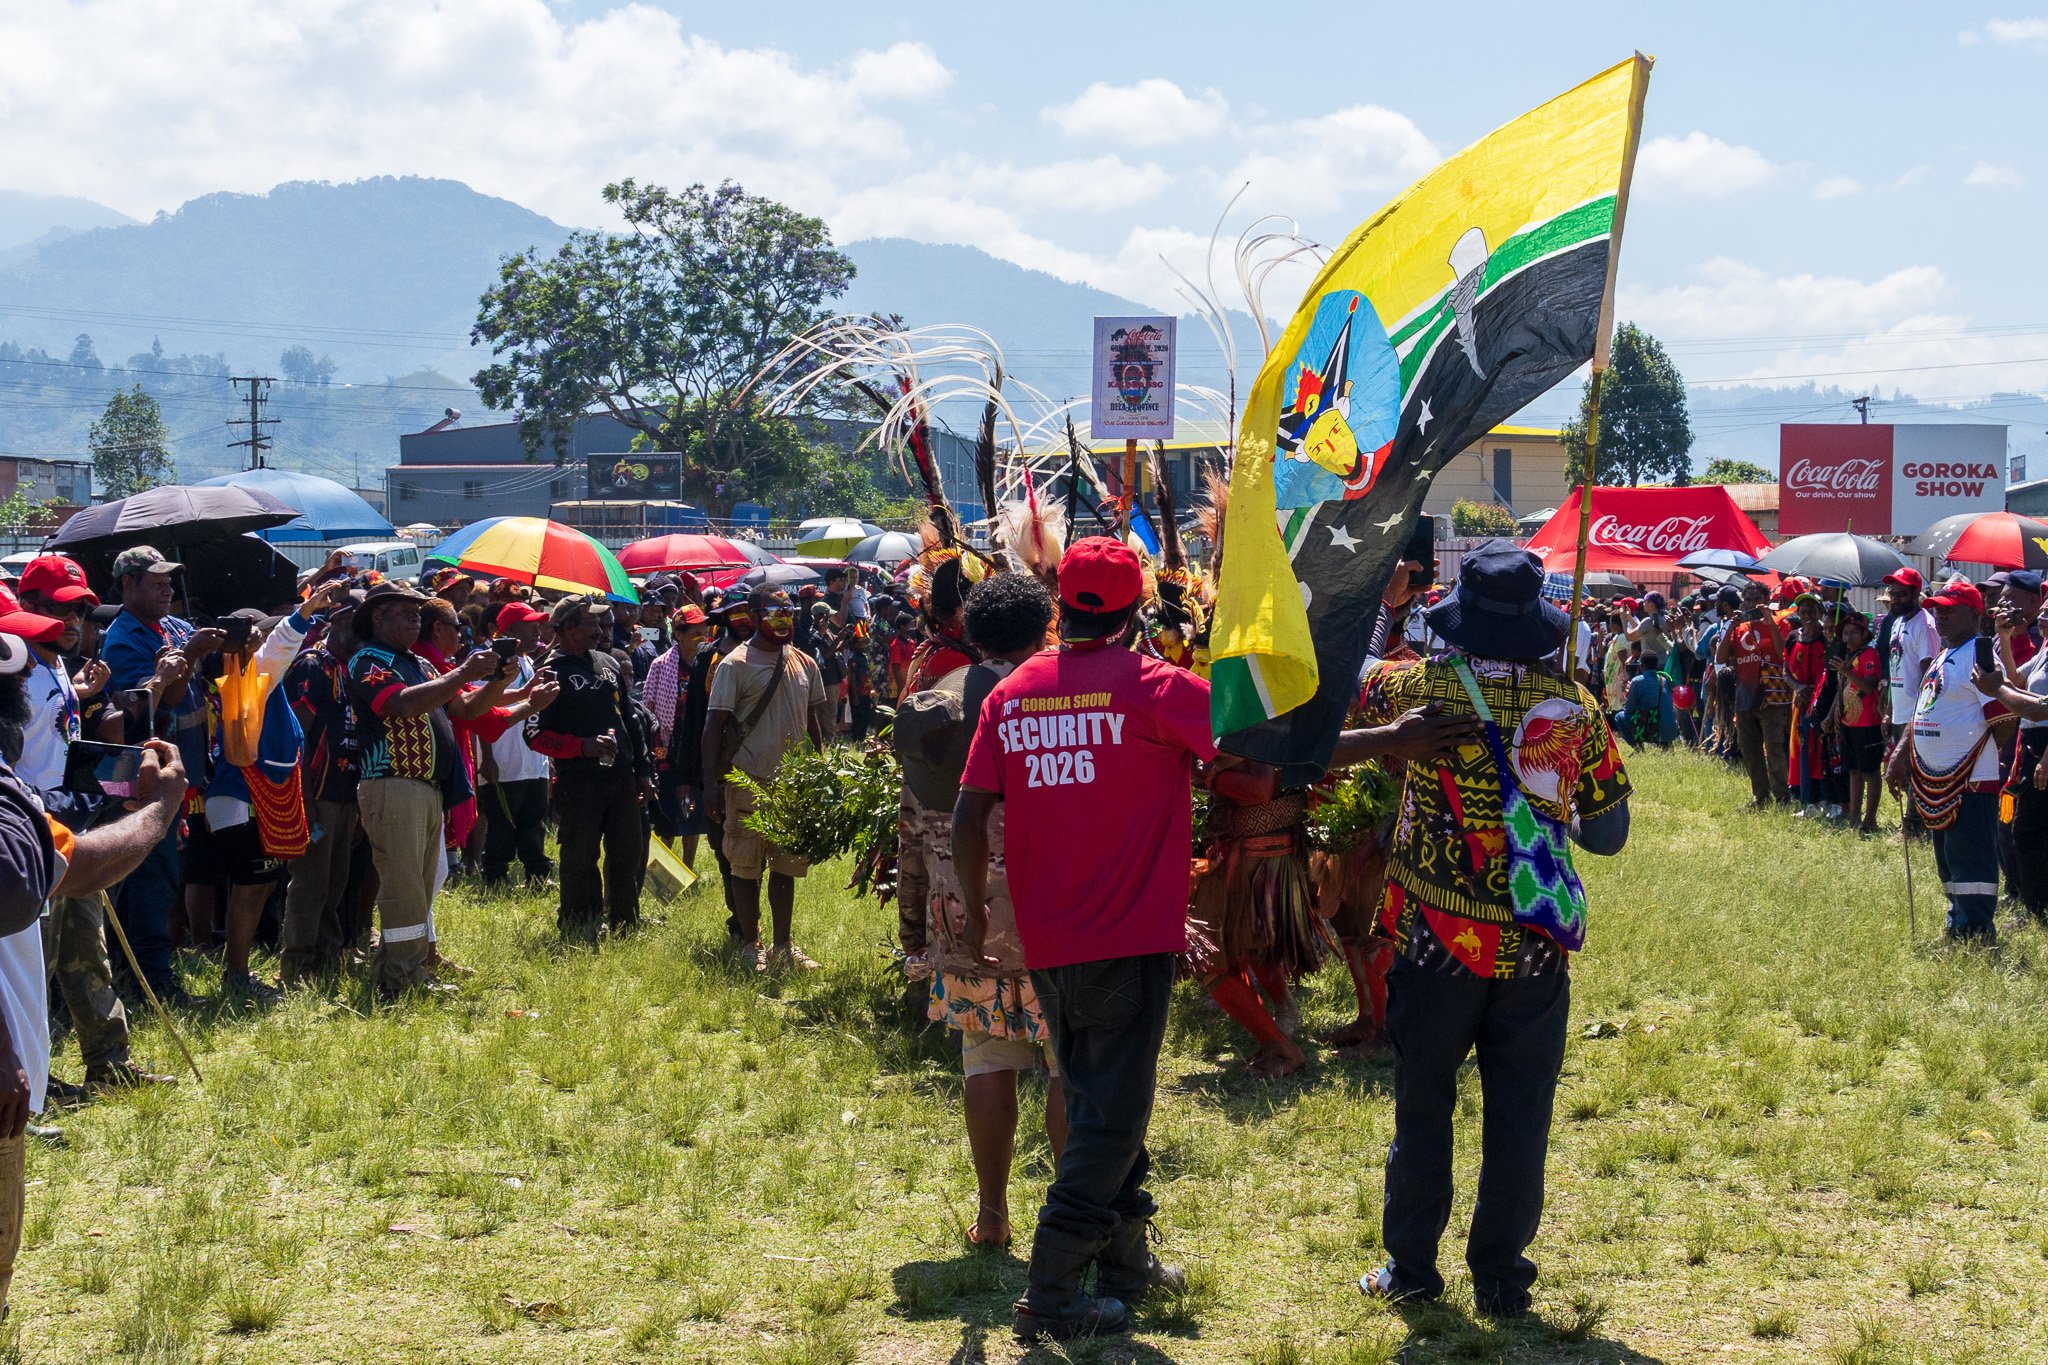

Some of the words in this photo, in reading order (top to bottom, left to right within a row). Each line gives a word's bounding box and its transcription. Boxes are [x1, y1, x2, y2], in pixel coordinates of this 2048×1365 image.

[1786, 458, 1886, 490] Coca-Cola
[1902, 463, 1998, 479] GOROKA
[1812, 491, 1836, 499] drink,
[1915, 481, 1985, 498] SHOW
[1588, 515, 1715, 552] Coca-Cola
[1021, 696, 1071, 713] GOROKA
[1073, 693, 1112, 709] SHOW
[997, 712, 1126, 755] SECURITY
[1025, 750, 1096, 788] 2026
